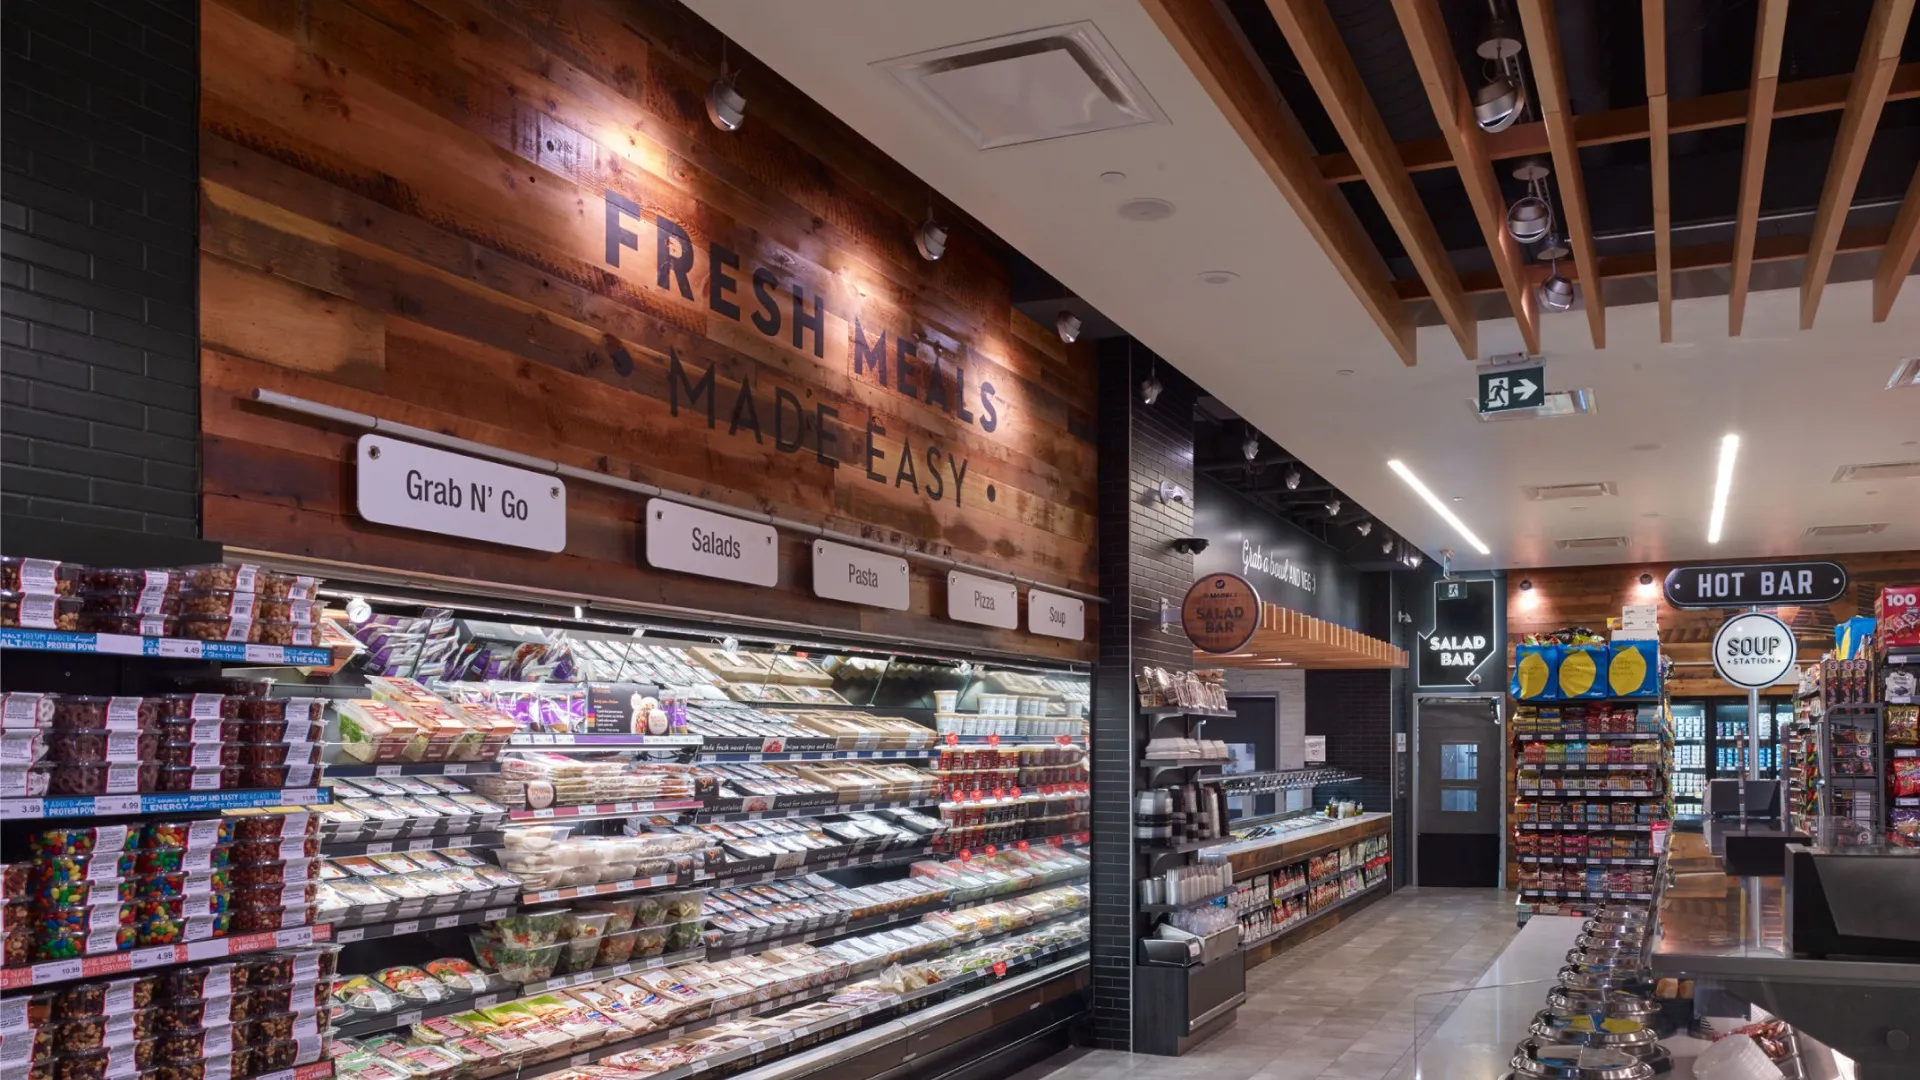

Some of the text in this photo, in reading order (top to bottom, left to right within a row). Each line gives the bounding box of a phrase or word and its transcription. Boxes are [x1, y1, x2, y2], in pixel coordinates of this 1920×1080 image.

[604, 188, 997, 434] FRESH MEALS
[667, 344, 968, 508] MADE EASY
[405, 469, 463, 509] Grab
[500, 490, 529, 522] Go
[691, 527, 742, 560] Salads
[1242, 538, 1263, 576] Grab
[1270, 551, 1289, 582] bowl
[1289, 565, 1301, 587] AND
[848, 563, 879, 589] Pasta
[1698, 569, 1813, 599] HOT BAR
[974, 590, 996, 611] Pizza
[1885, 593, 1917, 608] 100
[1049, 606, 1066, 627] Soup
[1196, 606, 1245, 620] SALAD
[1205, 620, 1235, 634] BAR
[47, 641, 77, 650] PROTEIN
[78, 643, 96, 651] POW
[184, 646, 200, 654] 4.49
[1429, 635, 1486, 651] SALAD
[1727, 635, 1781, 657] SOUP
[308, 656, 328, 665] SALT
[1440, 651, 1475, 667] BAR
[1733, 657, 1775, 665] STATION
[221, 793, 238, 801] TASTY
[22, 804, 41, 813] 3.99
[49, 807, 79, 816] PROTEIN
[122, 802, 139, 810] 4.99
[150, 803, 189, 812] ENERGY
[157, 951, 173, 961] 4.99
[62, 966, 80, 976] 10.99
